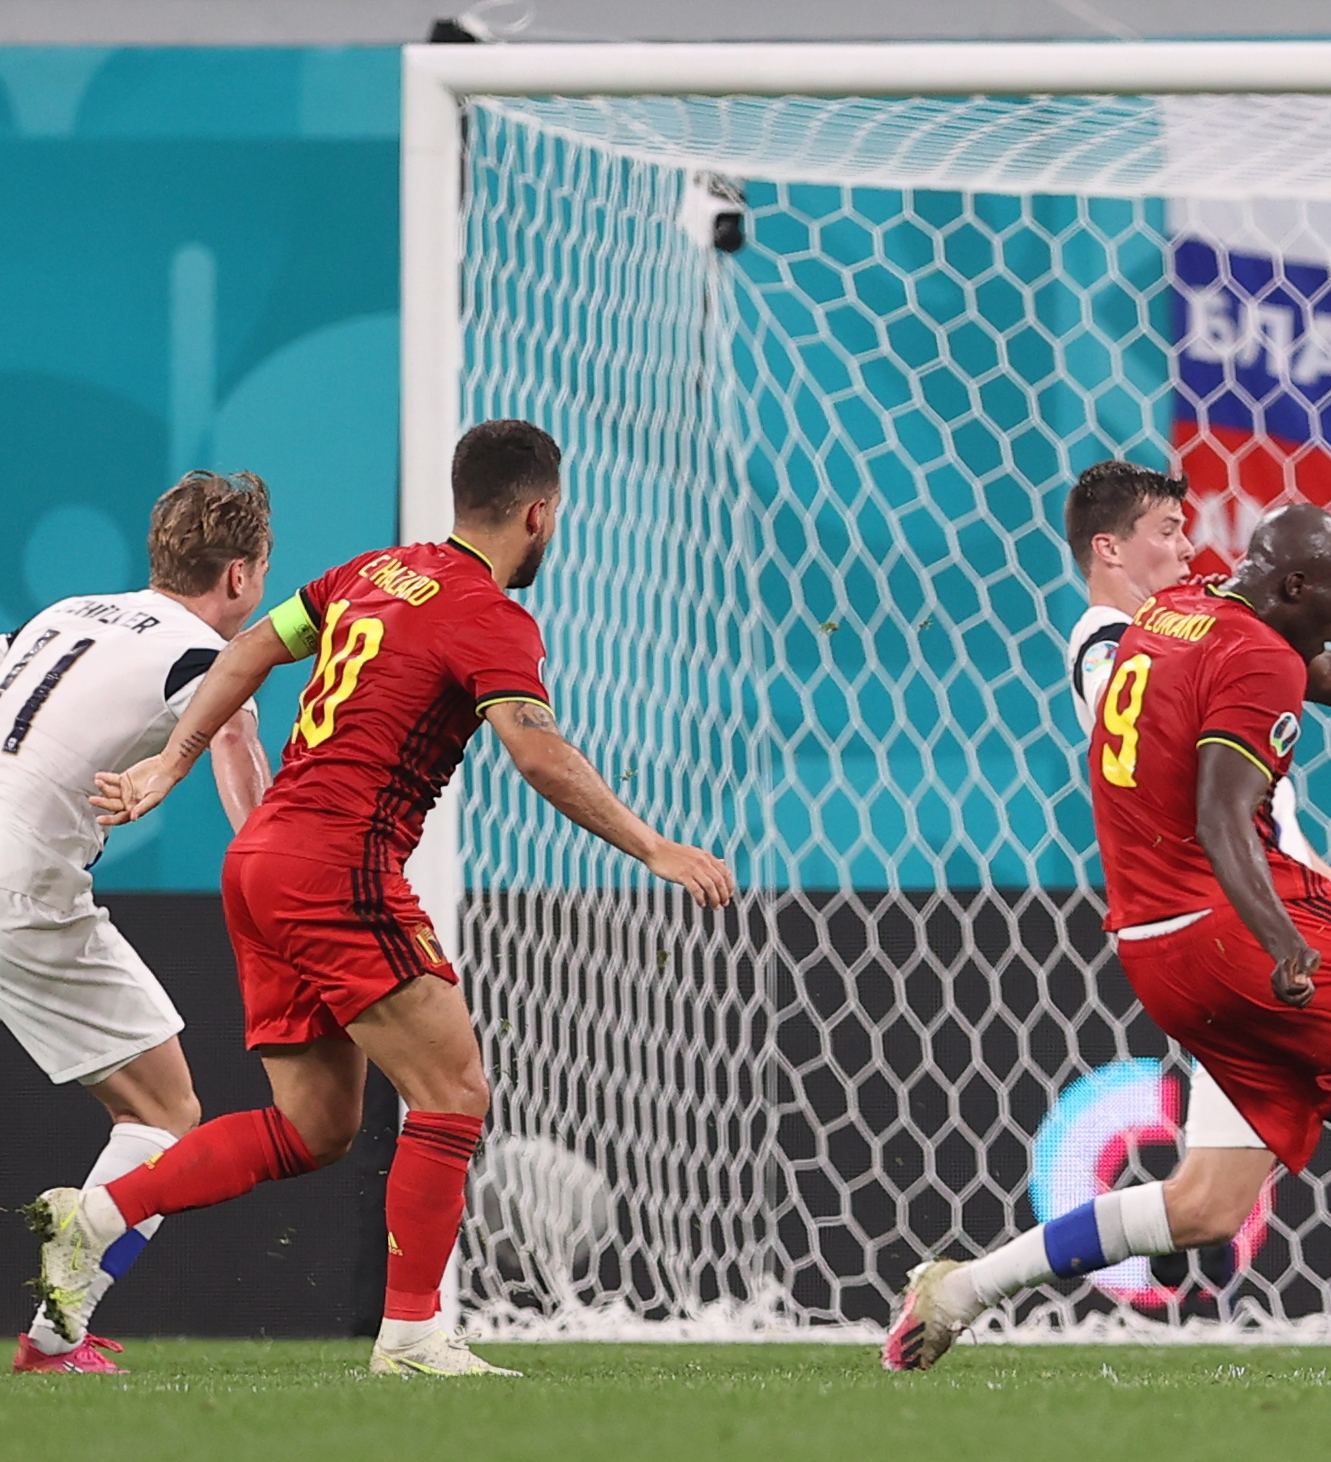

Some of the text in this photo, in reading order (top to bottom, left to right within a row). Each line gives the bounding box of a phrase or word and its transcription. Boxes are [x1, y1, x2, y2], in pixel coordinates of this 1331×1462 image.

[291, 598, 385, 750] 10
[1144, 606, 1217, 642] LUKAKU
[0, 628, 97, 757] 11
[1102, 653, 1153, 789] 9
